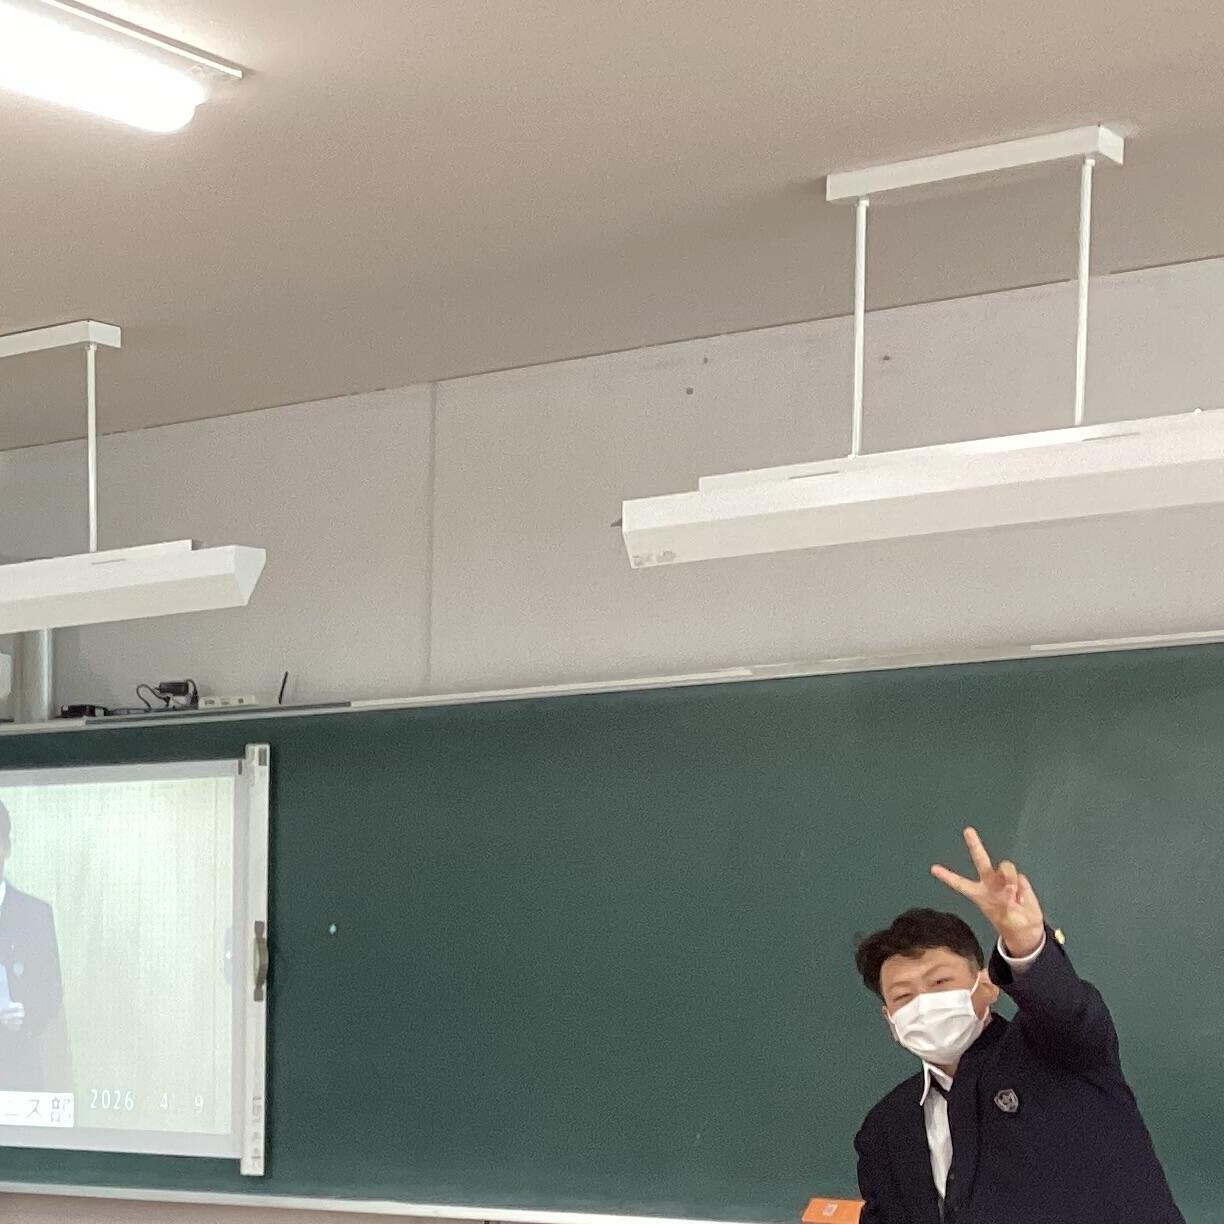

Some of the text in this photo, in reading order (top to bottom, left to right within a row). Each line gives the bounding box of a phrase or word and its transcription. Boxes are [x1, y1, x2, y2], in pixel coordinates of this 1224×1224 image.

[89, 1088, 204, 1115] 2026 4 9
